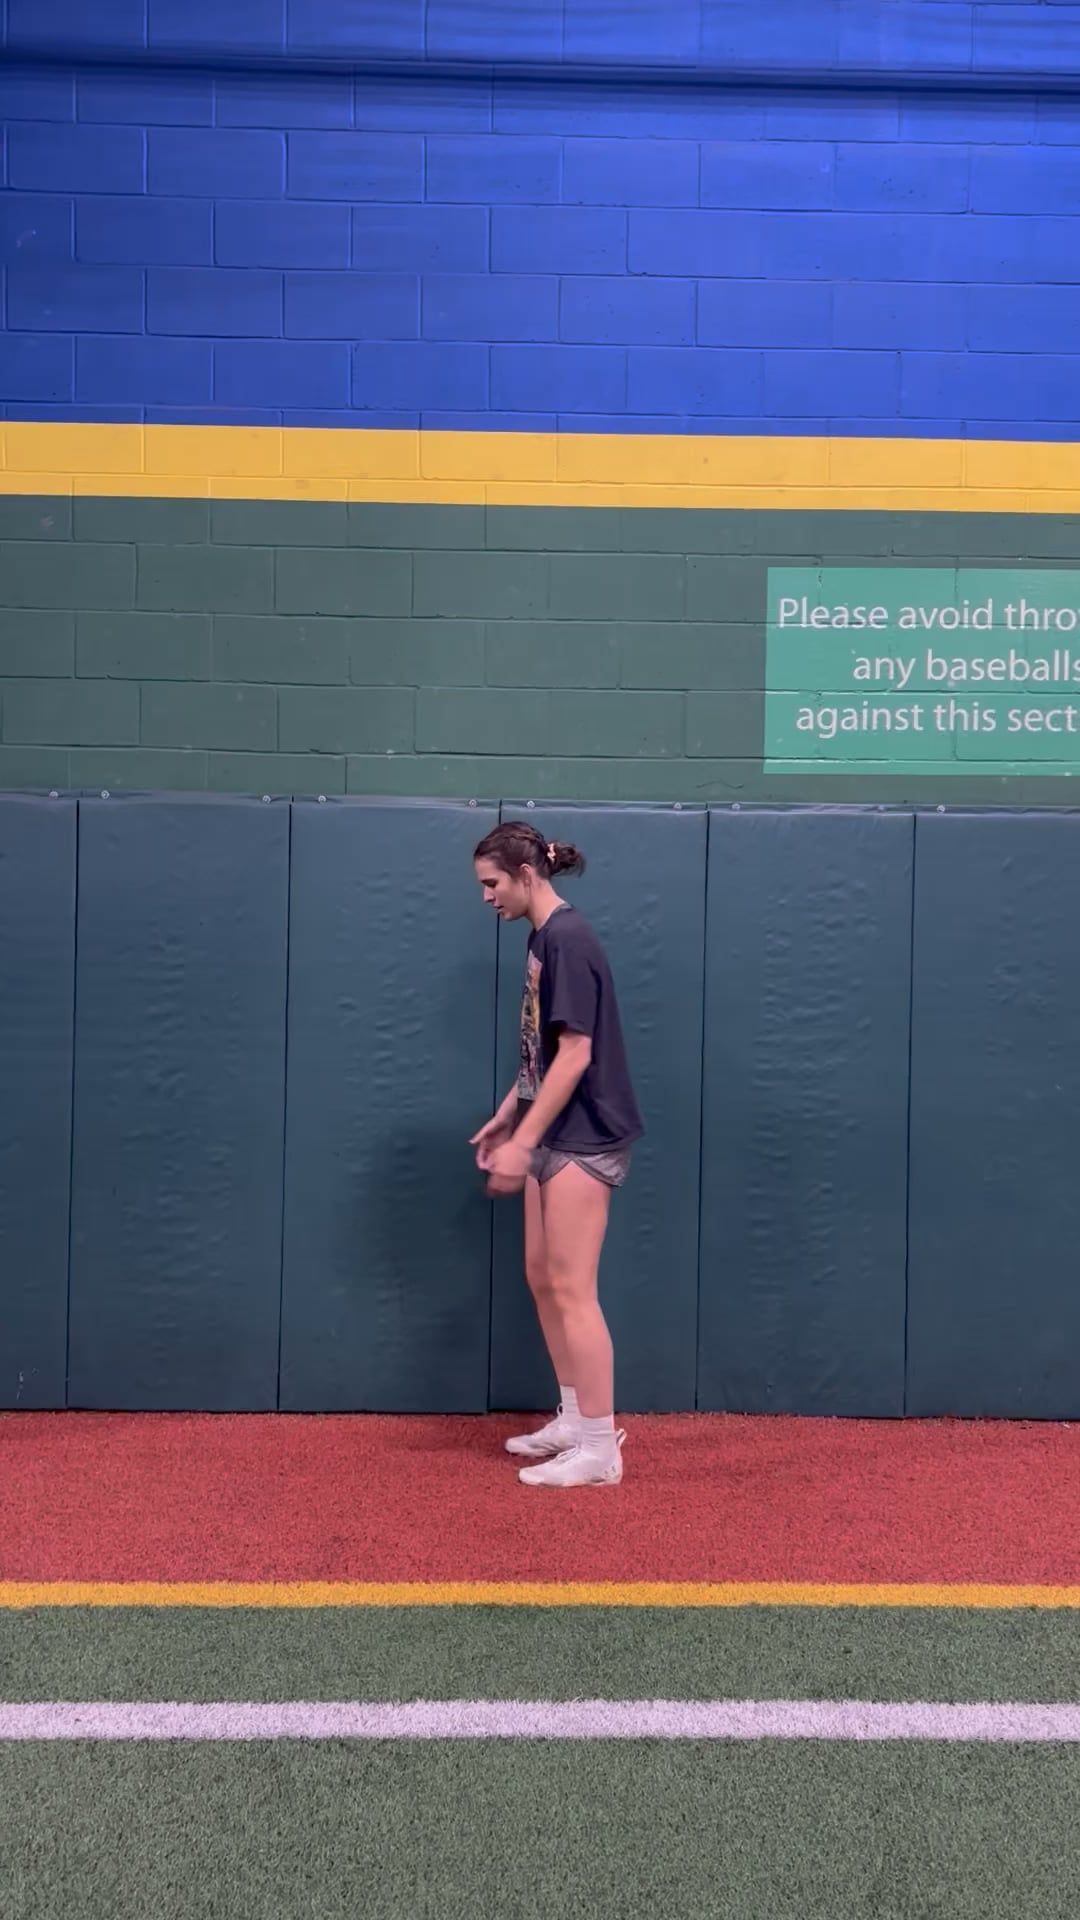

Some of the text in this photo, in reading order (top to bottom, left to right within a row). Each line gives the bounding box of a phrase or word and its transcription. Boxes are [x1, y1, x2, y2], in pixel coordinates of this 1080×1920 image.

[778, 597, 1080, 631] Please avoid thro
[852, 656, 917, 689] any
[795, 700, 924, 739] against
[933, 699, 997, 731] this
